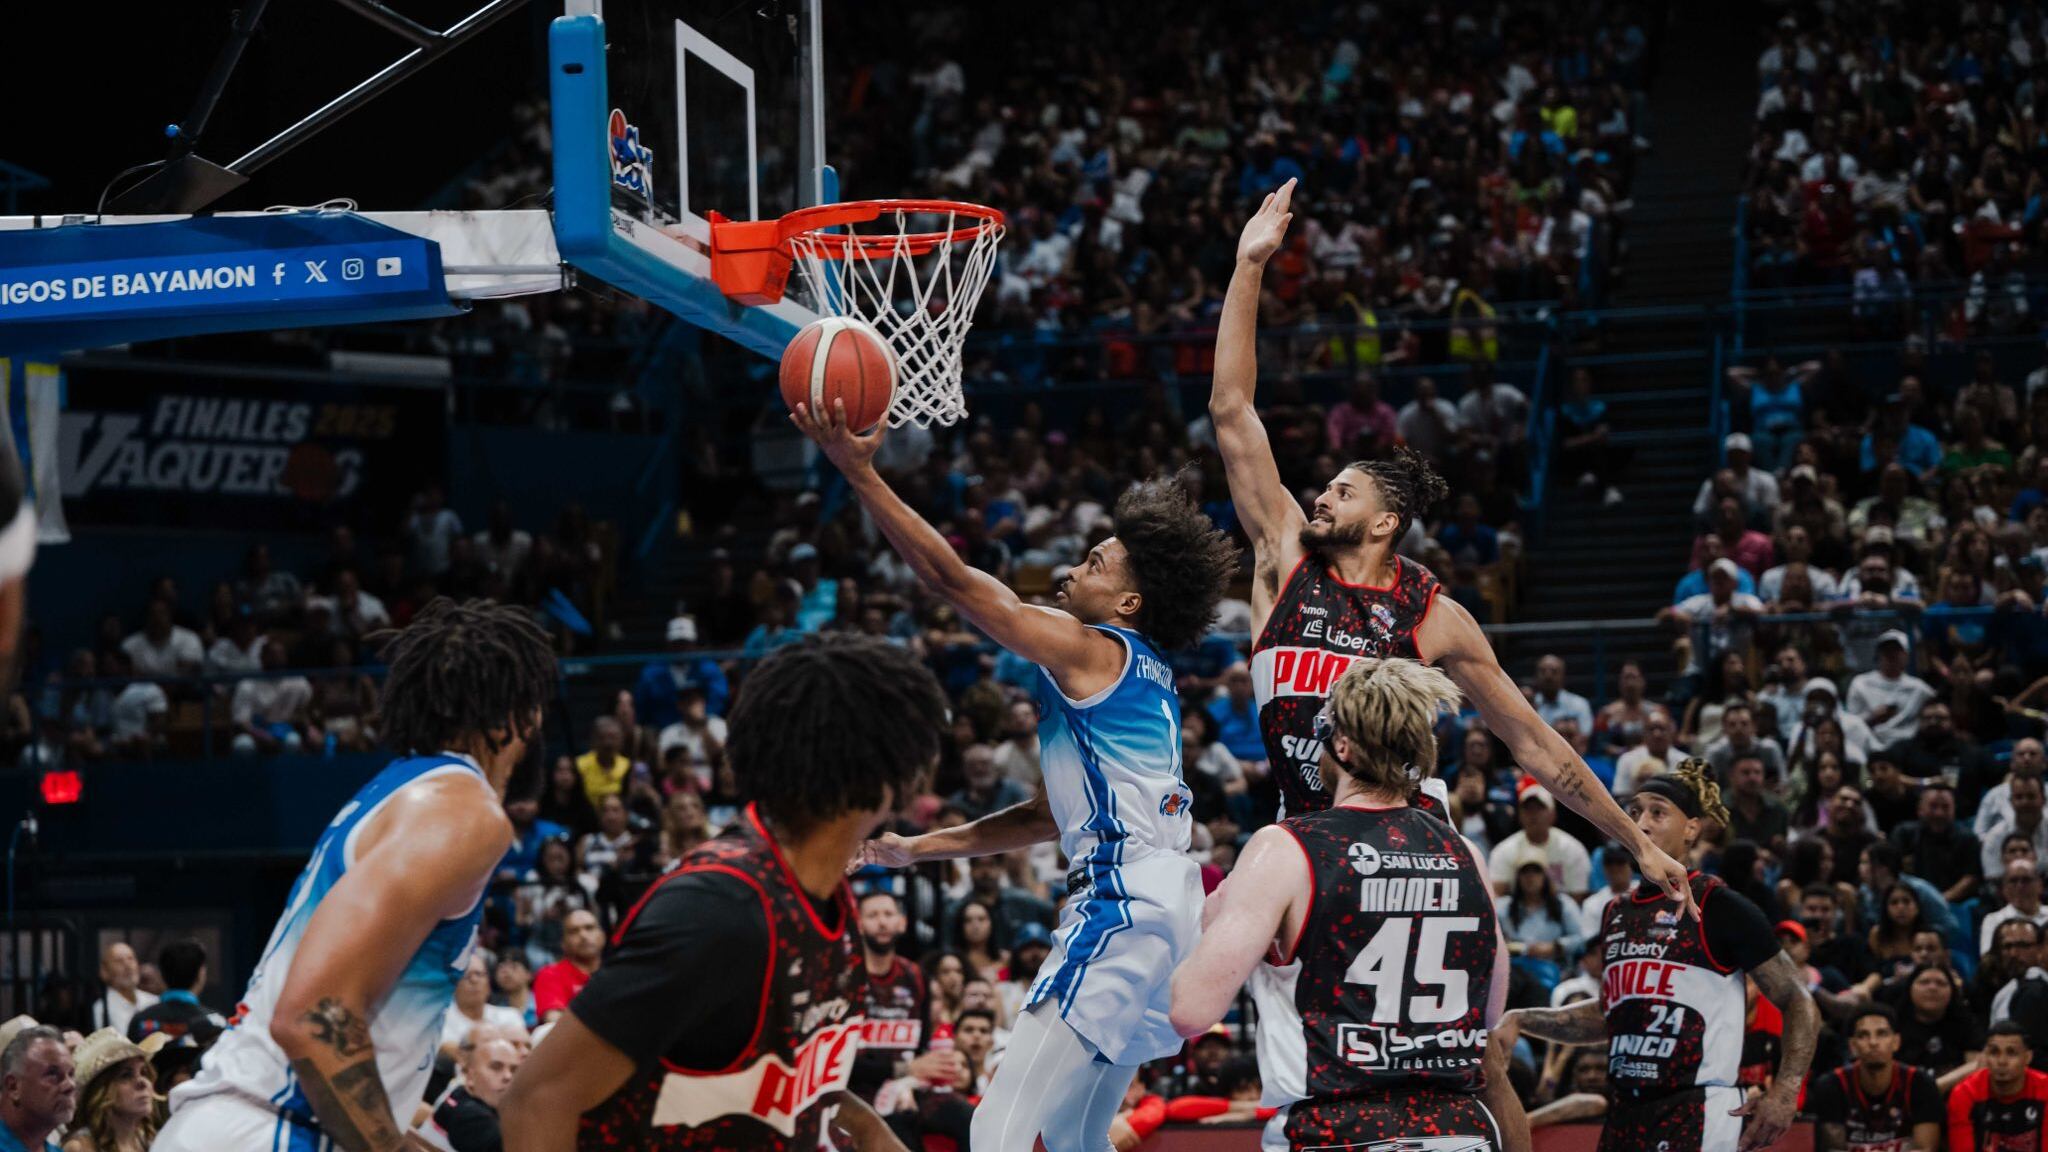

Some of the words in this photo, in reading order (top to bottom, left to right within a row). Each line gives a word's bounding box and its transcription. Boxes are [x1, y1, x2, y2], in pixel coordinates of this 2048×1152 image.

[72, 275, 106, 299] DE
[112, 265, 256, 297] BAYAMON
[151, 395, 312, 442] FINALES
[1381, 855, 1412, 869] SAN
[1414, 857, 1459, 871] LUCAS
[1360, 877, 1460, 912] MANEK
[1620, 941, 1669, 959] Liberty
[1343, 916, 1480, 1023] 45
[1646, 1004, 1686, 1035] 24
